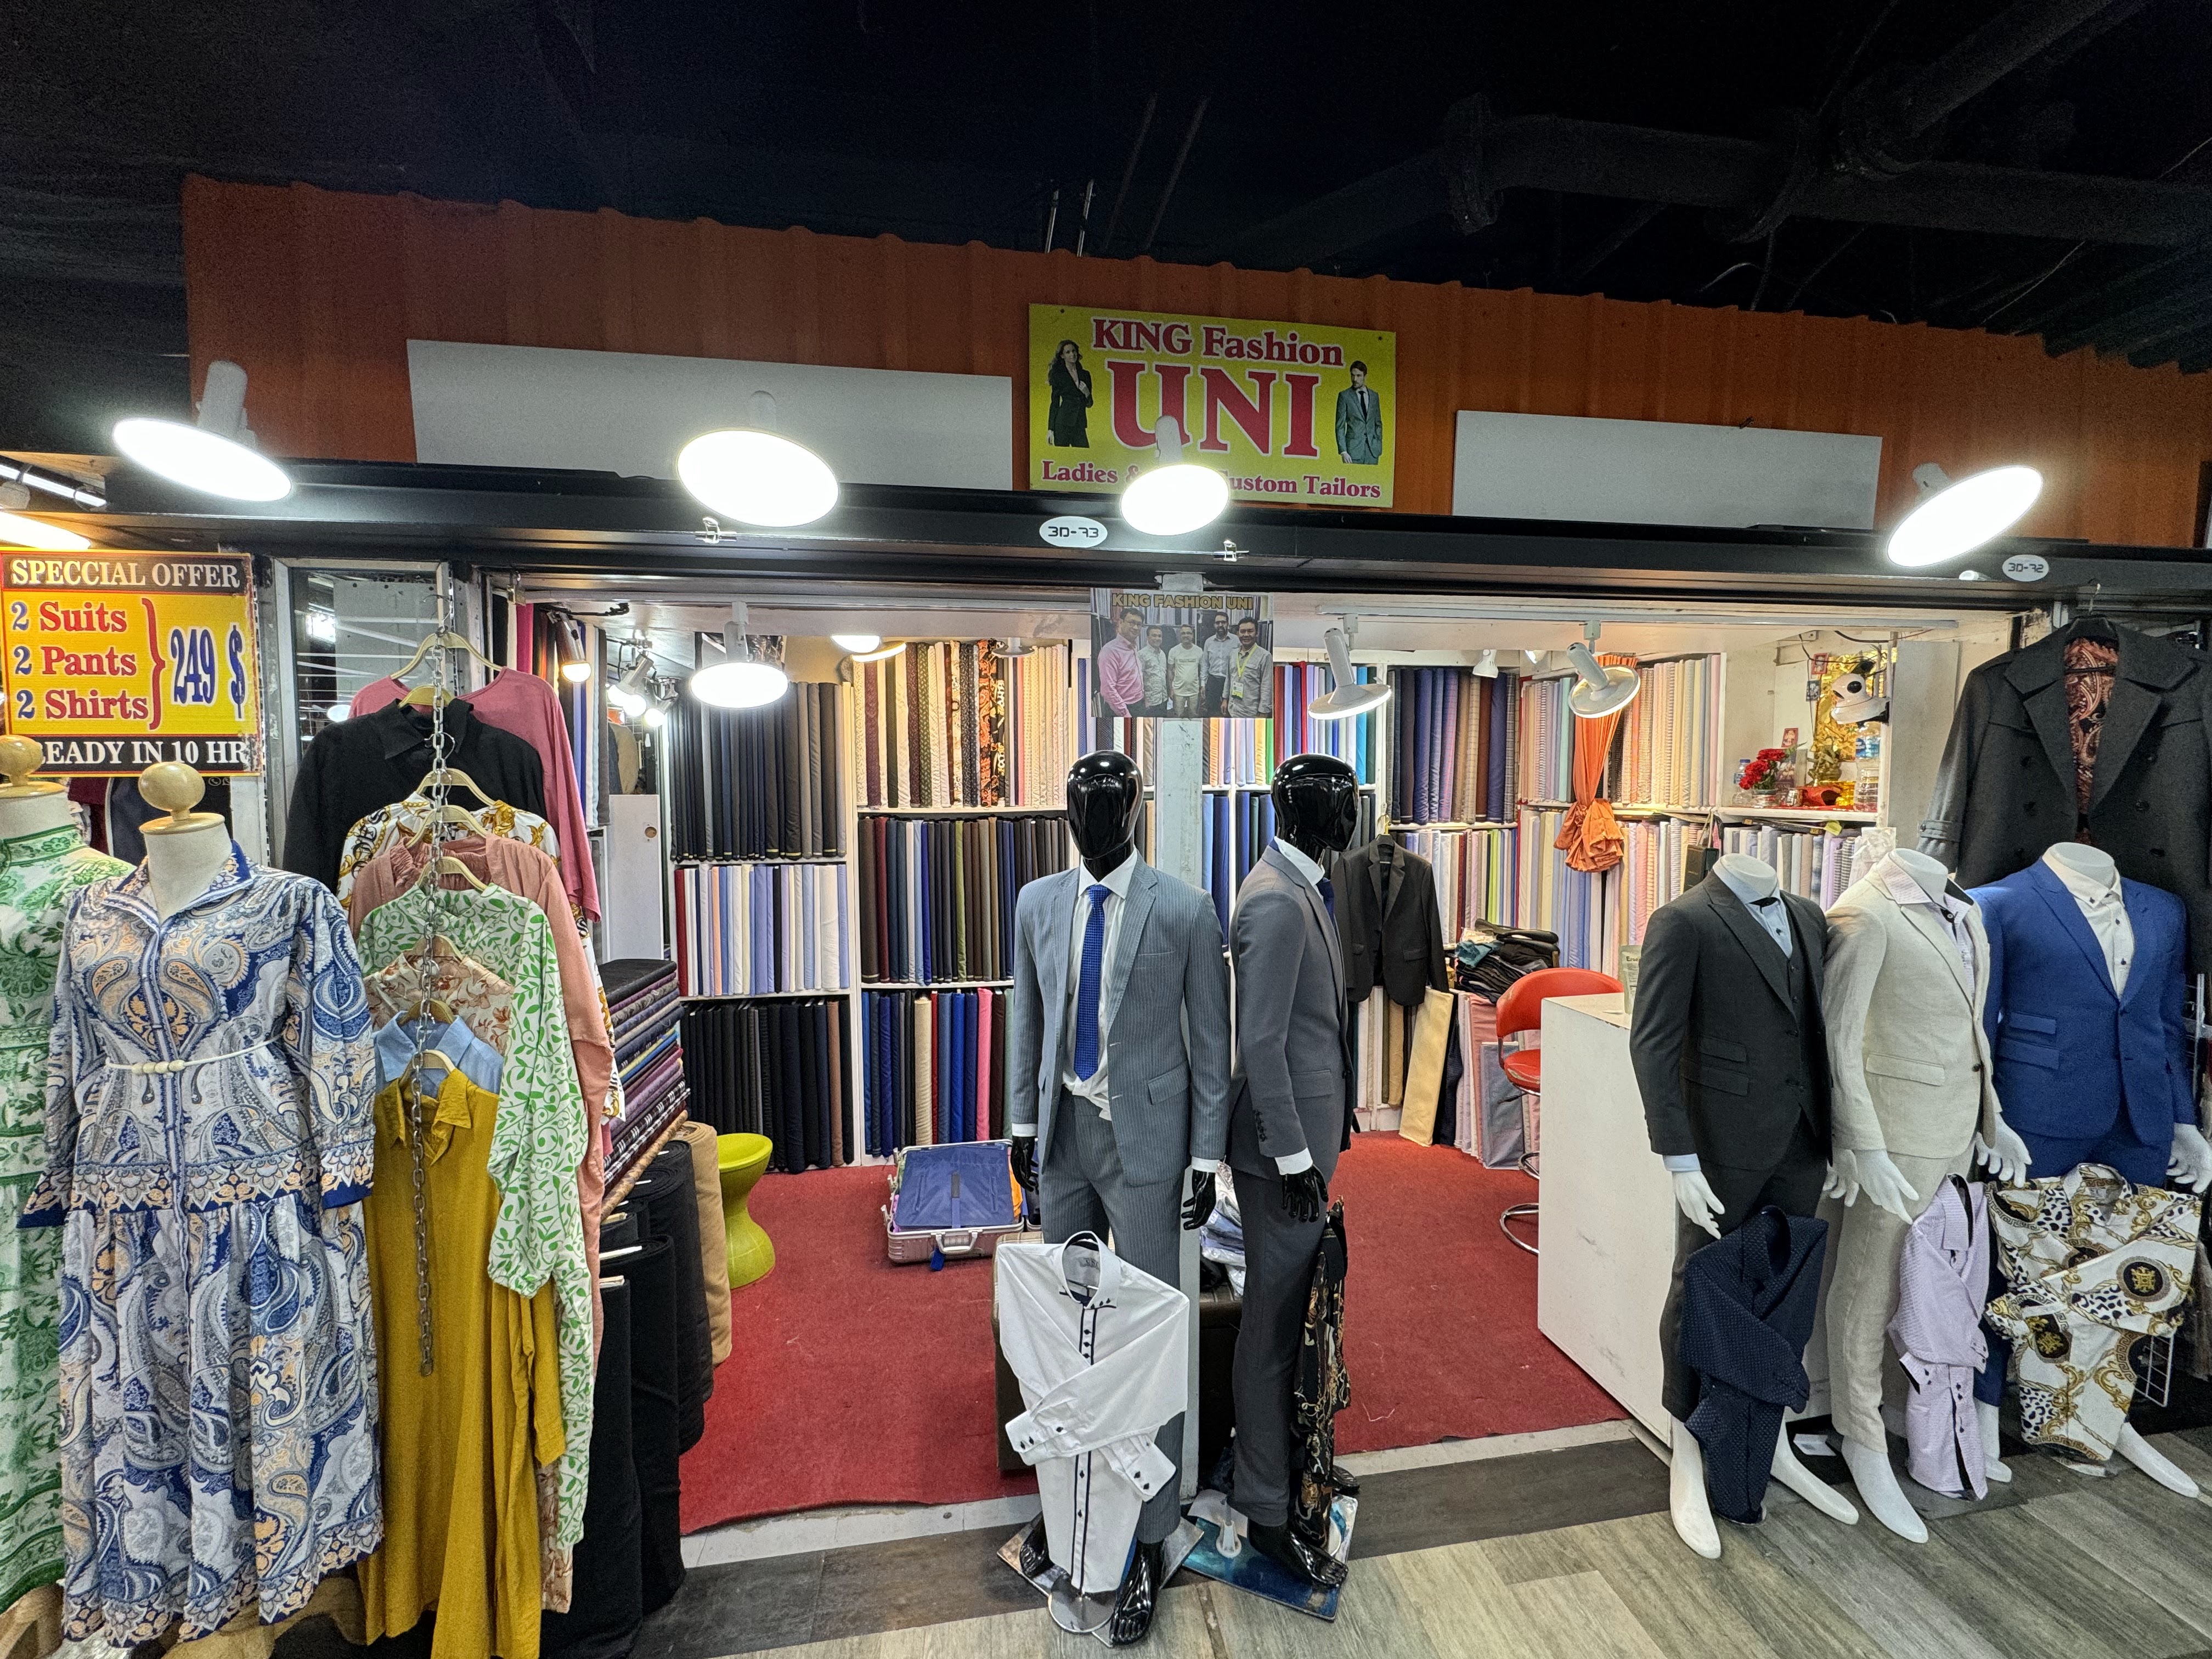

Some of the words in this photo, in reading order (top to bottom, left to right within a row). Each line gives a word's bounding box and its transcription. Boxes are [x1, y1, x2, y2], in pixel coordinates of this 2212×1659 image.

[1093, 319, 1192, 354] KING
[1203, 326, 1344, 366] Fashion
[1107, 361, 1319, 457] UNI
[1042, 460, 1118, 483] Ladies
[1219, 470, 1297, 493] ustom
[1304, 476, 1381, 499] Tailors
[10, 559, 146, 585] SPECCIAL
[151, 563, 240, 587] OFFER
[11, 601, 29, 631] 2
[40, 601, 127, 632] Suits
[1112, 594, 1151, 607] KING
[1153, 594, 1223, 609] FASHION
[1226, 596, 1253, 610] UNI
[14, 646, 32, 675] 2
[41, 646, 137, 676] Pants
[171, 629, 216, 704] 249
[16, 690, 35, 719] 2
[45, 689, 149, 720] Shirts
[42, 741, 125, 764] EADY
[131, 741, 163, 764] IN
[172, 741, 199, 764] 10
